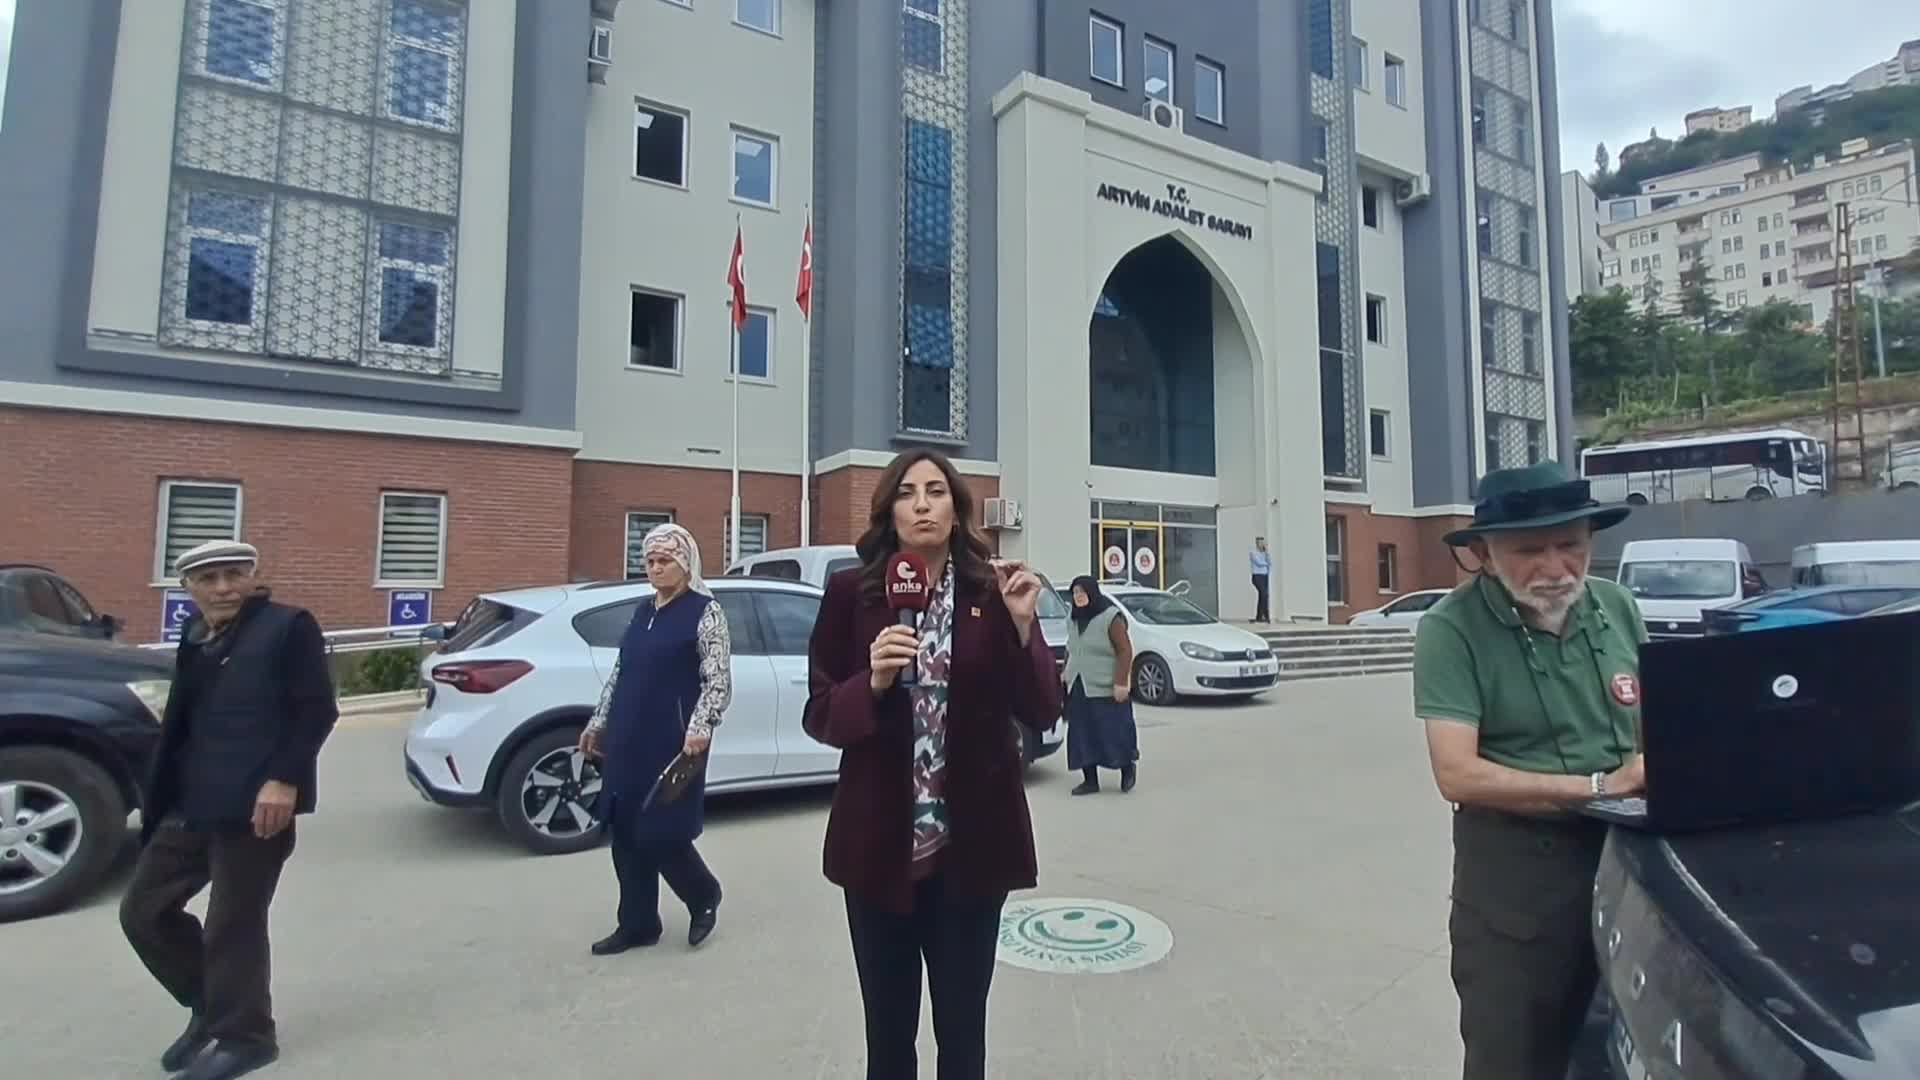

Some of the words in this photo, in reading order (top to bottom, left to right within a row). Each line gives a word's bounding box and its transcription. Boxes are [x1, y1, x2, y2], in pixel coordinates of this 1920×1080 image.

[1167, 184, 1190, 204] T.C.
[1152, 199, 1205, 226] ADALET
[892, 581, 922, 591] anka
